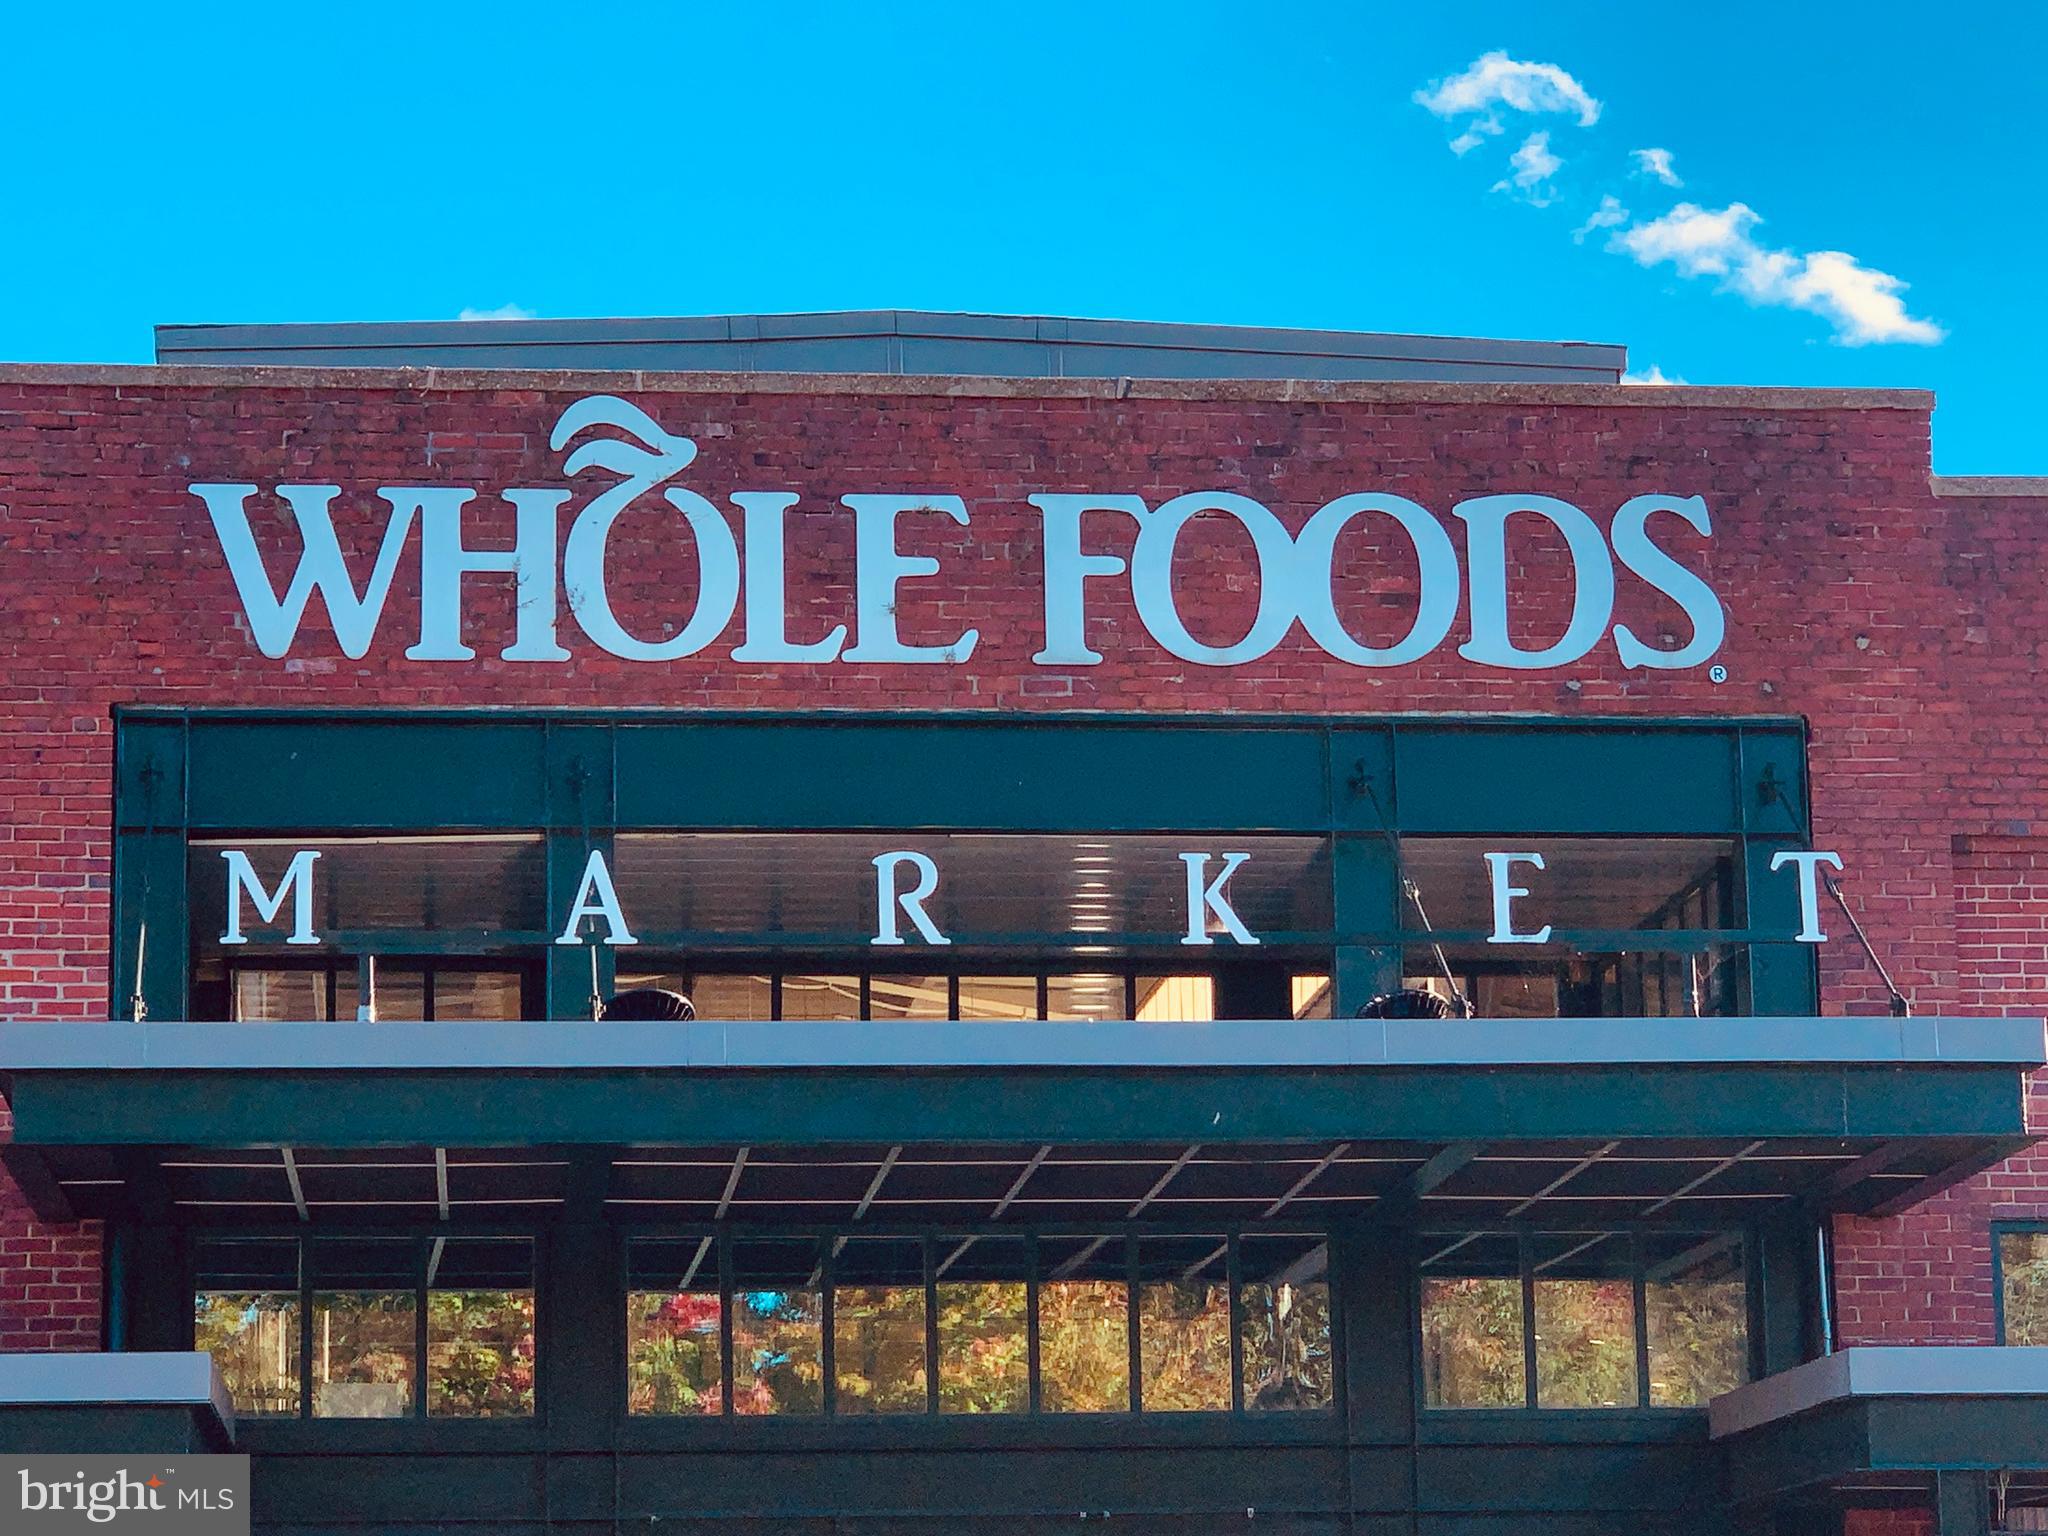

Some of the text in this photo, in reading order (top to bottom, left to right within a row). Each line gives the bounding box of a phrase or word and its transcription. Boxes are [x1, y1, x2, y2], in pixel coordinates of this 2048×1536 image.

[188, 395, 980, 664] WHOLE
[1027, 491, 1726, 670] FOODS
[218, 849, 1844, 947] MARKET
